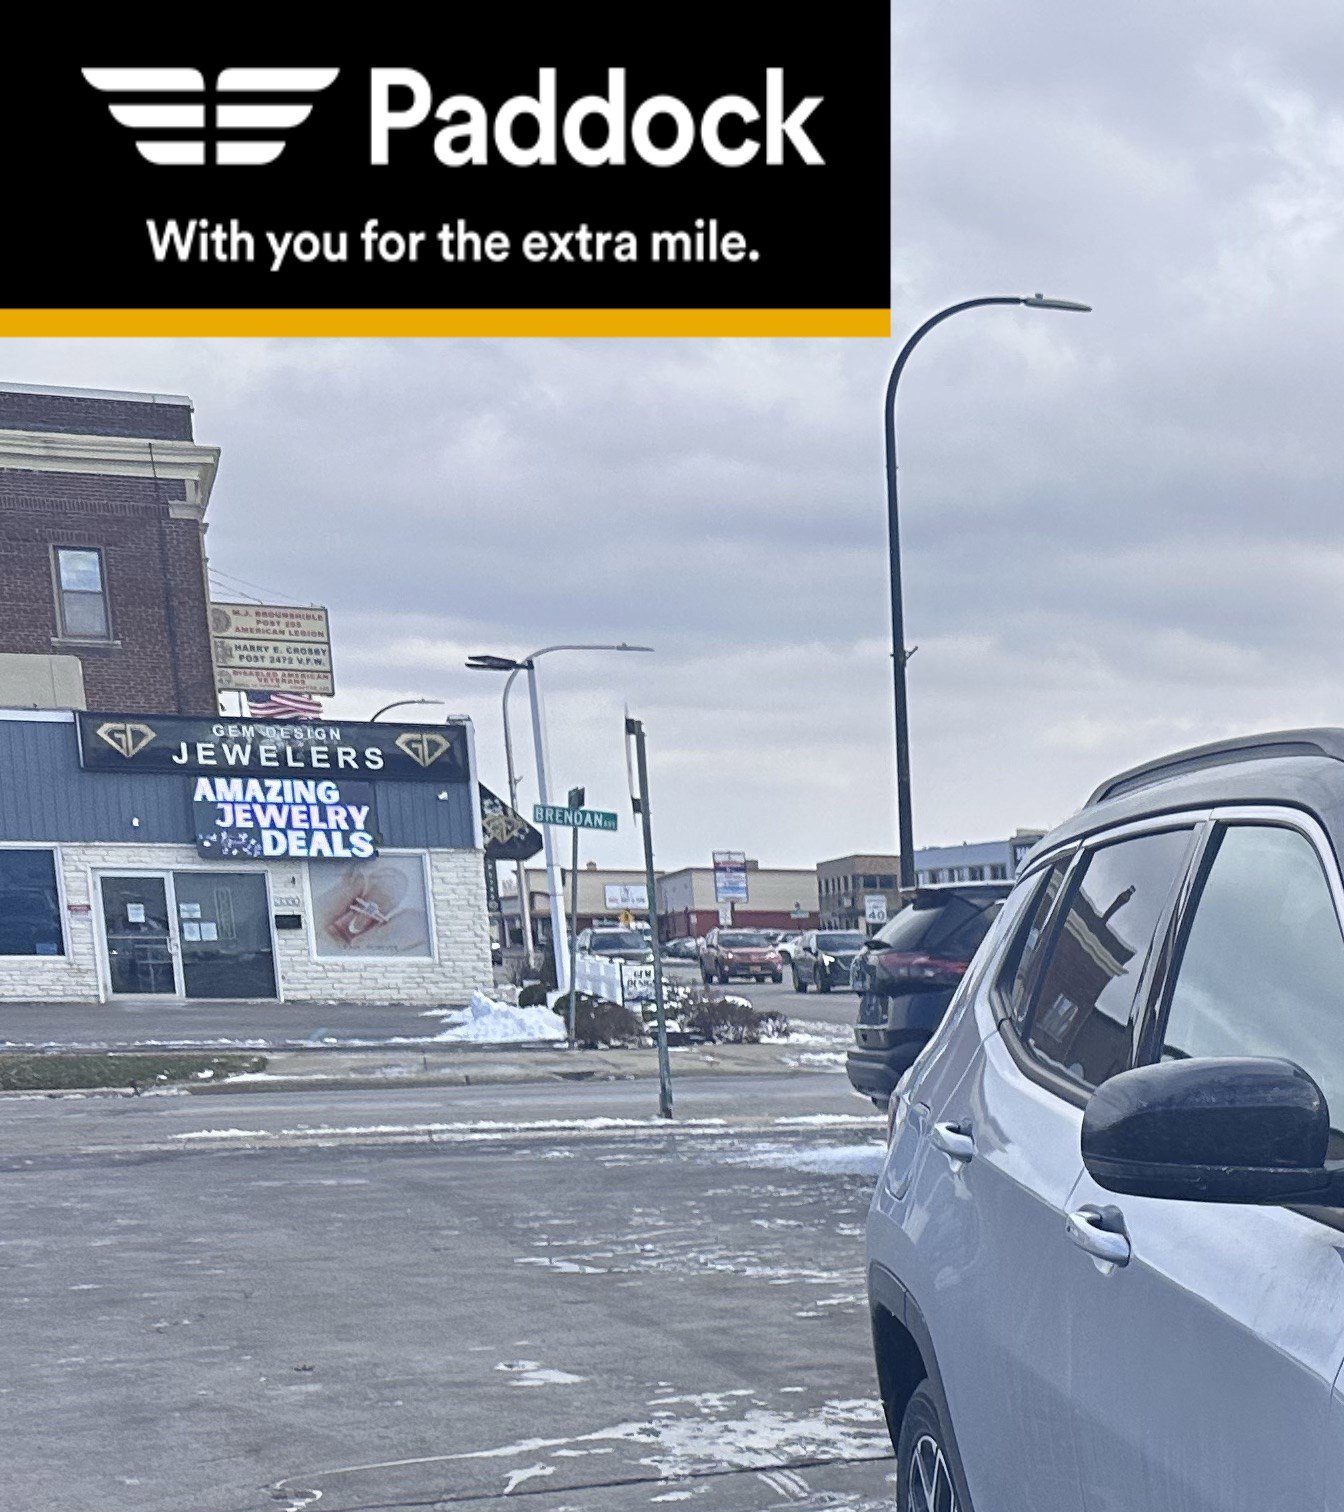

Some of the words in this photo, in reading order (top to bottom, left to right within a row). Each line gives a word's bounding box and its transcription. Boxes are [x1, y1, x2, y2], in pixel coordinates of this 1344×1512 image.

[235, 626, 285, 636] AMERICAN
[288, 629, 325, 637] LEGION
[234, 644, 269, 653] HARRY
[286, 647, 327, 656] CROSBY
[239, 654, 266, 663] POST
[281, 672, 329, 680] AMERICAN
[212, 724, 255, 738] GEM
[266, 726, 342, 740] DESIGN
[172, 741, 385, 770] JEWELERS
[193, 776, 340, 804] AMAZING
[215, 803, 370, 830] JEWELRY
[535, 807, 603, 828] BRENDAN
[262, 829, 375, 858] DEALS
[868, 910, 885, 921] 40
